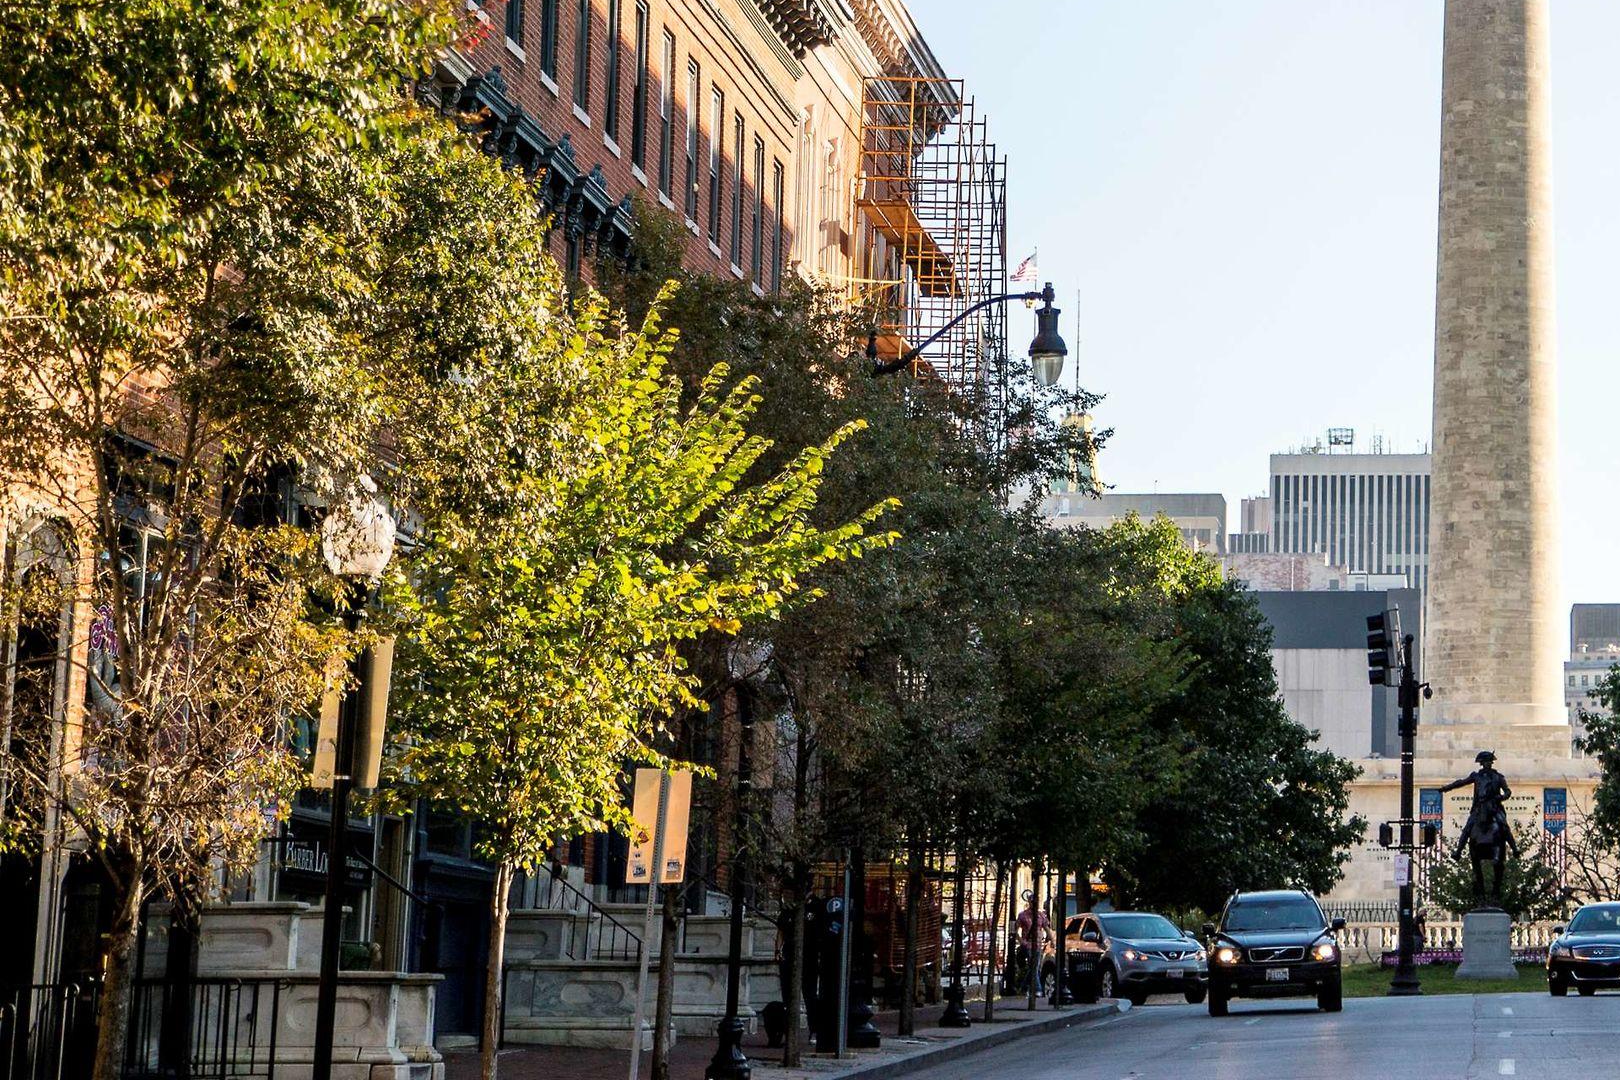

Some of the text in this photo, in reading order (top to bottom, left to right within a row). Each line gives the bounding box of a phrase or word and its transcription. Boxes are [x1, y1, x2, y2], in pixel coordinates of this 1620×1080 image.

[1422, 805, 1441, 814] 1815
[1546, 805, 1566, 814] 1815
[1545, 820, 1566, 828] 2015
